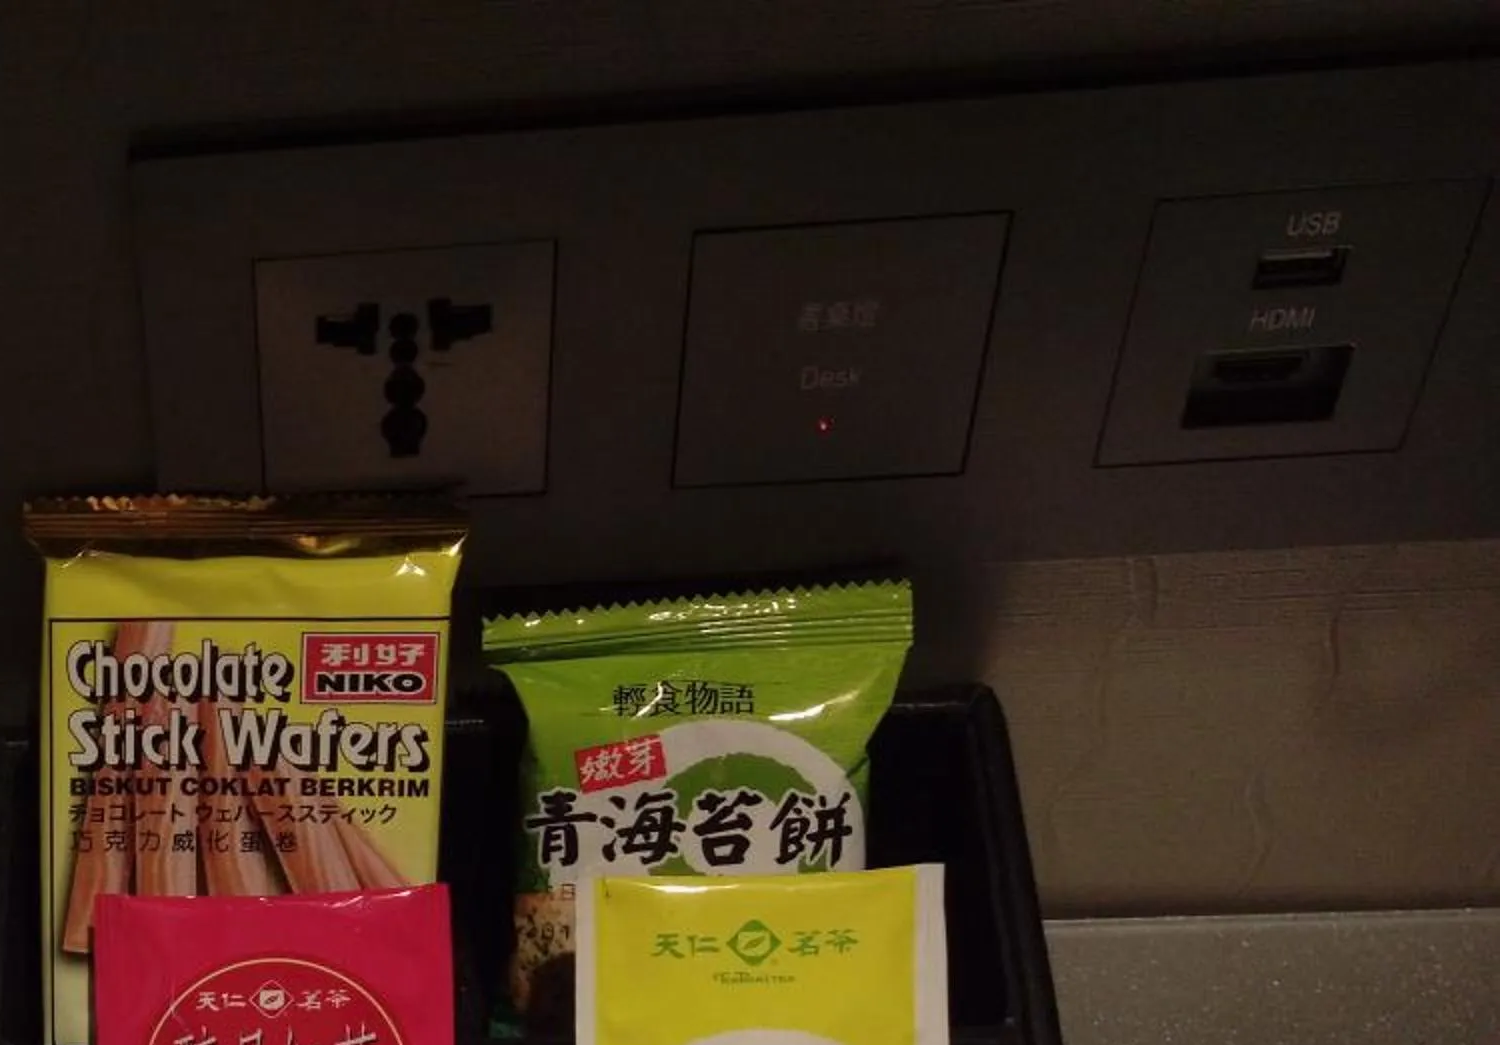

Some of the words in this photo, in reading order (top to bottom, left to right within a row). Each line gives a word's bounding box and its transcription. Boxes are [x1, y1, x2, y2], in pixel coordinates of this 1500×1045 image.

[1285, 208, 1343, 237] USB
[1249, 304, 1317, 332] HDMI
[800, 365, 862, 389] Desk
[66, 638, 294, 701] Chocolate
[314, 670, 428, 695] NIKO
[611, 679, 757, 717] 輕食物語
[67, 708, 205, 772] Stick
[218, 708, 430, 772] Wafers
[580, 737, 662, 784] 嫩芽
[69, 777, 172, 797] BISKUT
[180, 777, 291, 797] COKLAT
[300, 777, 430, 797] BERKRIM
[68, 803, 185, 824] チョコレート
[525, 788, 854, 868] 青海苔餅
[650, 933, 720, 959] 天仁
[787, 928, 860, 957] 茗茶
[195, 990, 247, 1012] 天仁
[297, 988, 352, 1012] 茗茶
